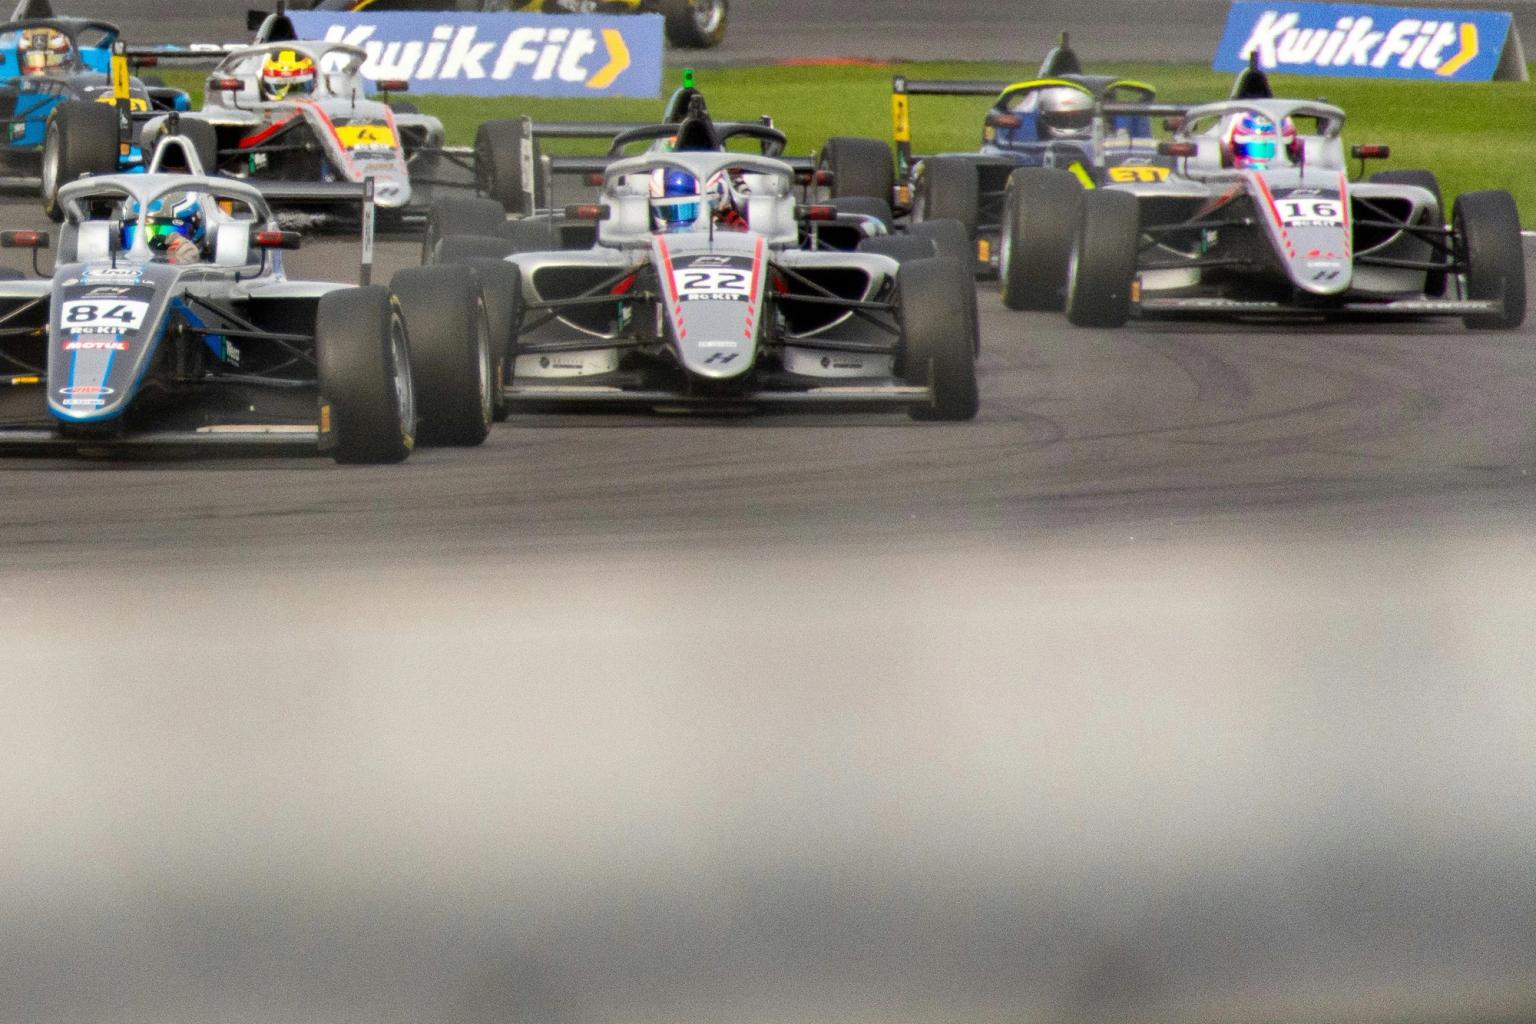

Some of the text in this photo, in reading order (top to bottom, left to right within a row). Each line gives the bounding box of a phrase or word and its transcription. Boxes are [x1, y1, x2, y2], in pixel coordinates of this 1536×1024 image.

[1284, 202, 1338, 218] 16
[683, 272, 746, 290] 22
[66, 304, 137, 324] 84
[65, 341, 126, 351] MOTUL
